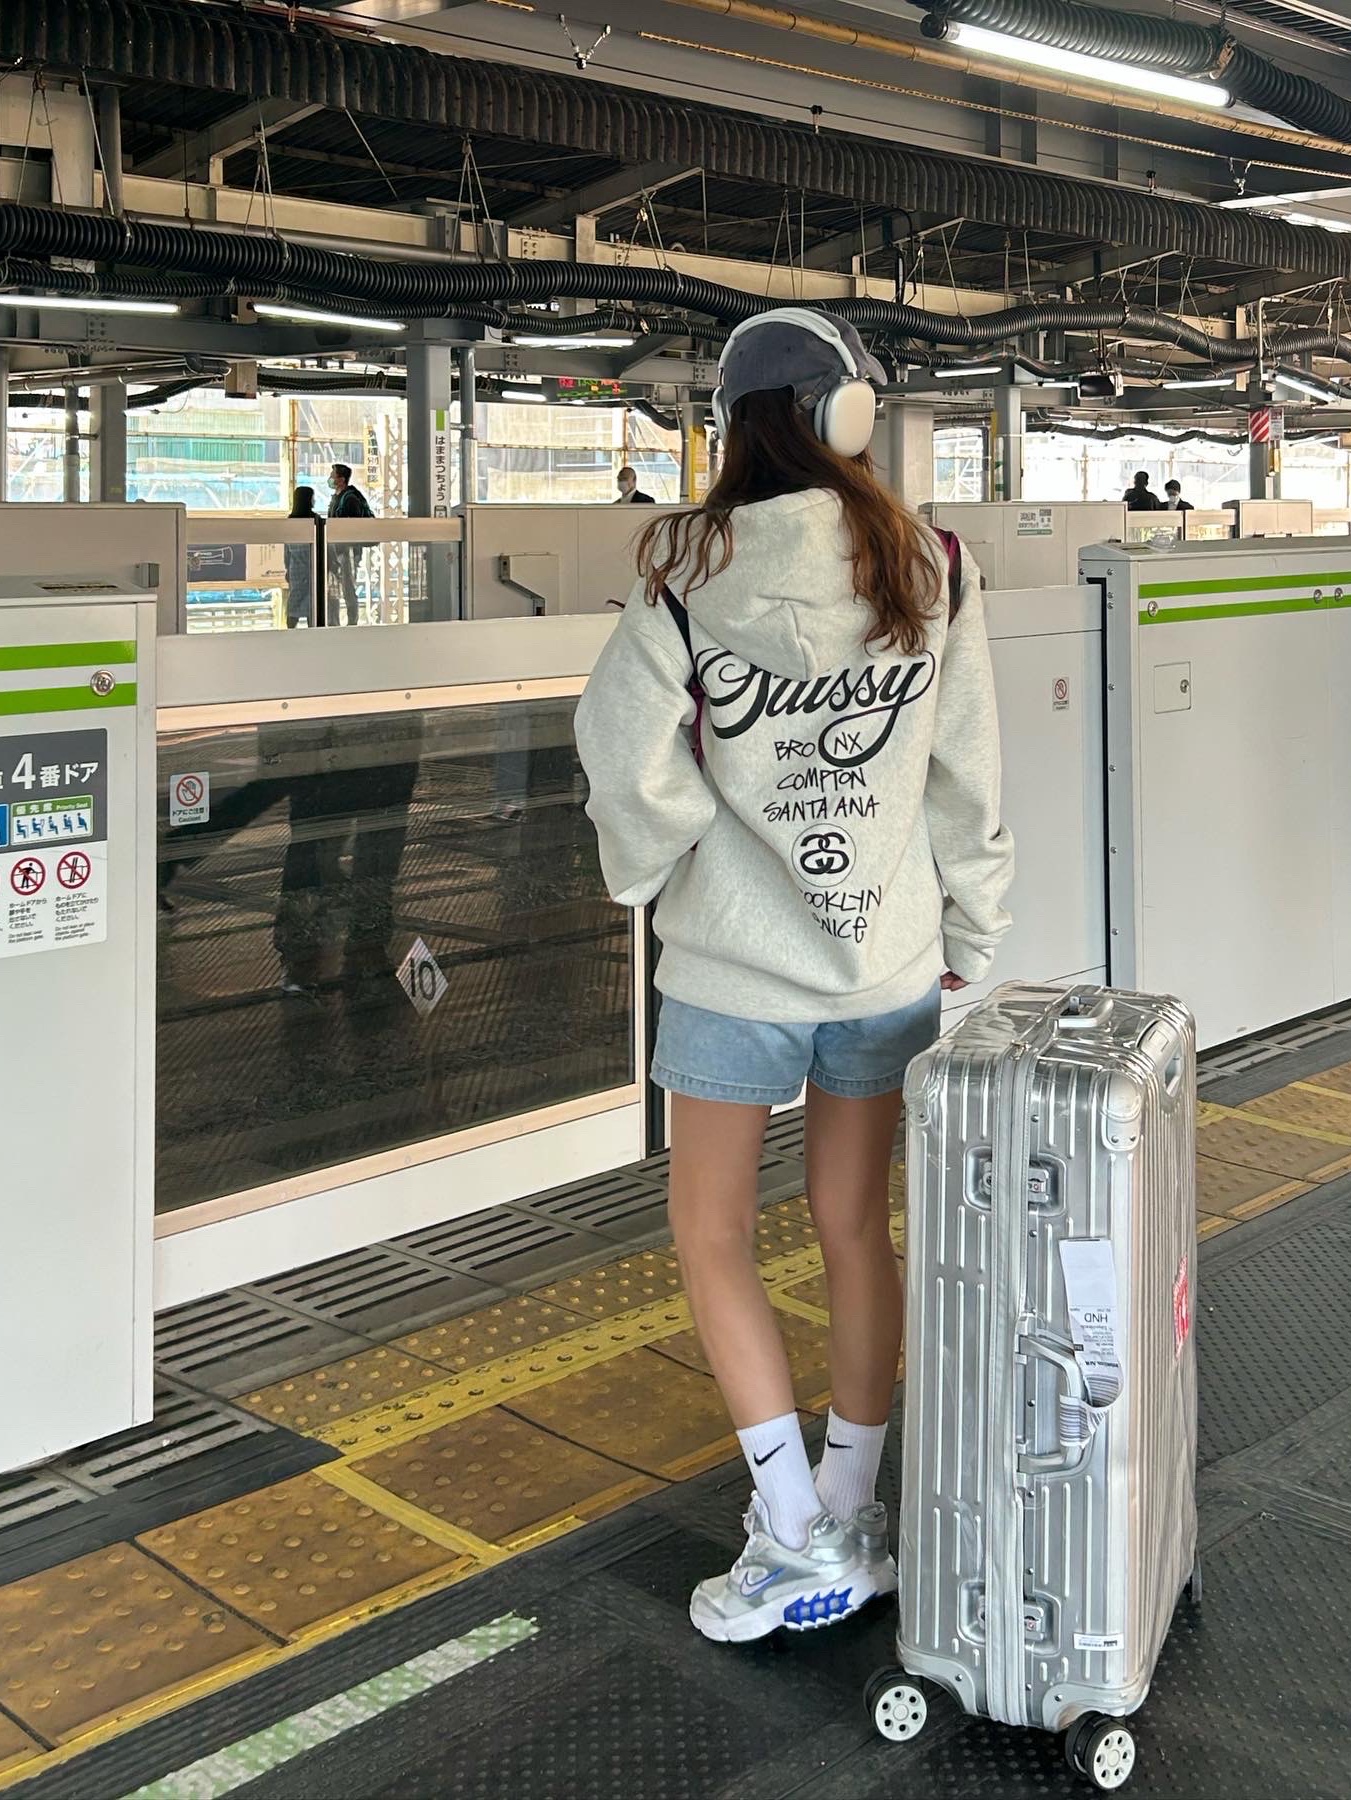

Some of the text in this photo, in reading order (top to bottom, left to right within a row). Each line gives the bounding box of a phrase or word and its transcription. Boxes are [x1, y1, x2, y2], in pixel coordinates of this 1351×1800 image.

[435, 435, 446, 501] はままつちょう
[777, 767, 866, 792] COMPTON
[763, 794, 880, 822] SANTA ANA
[1084, 1312, 1108, 1323] HND
